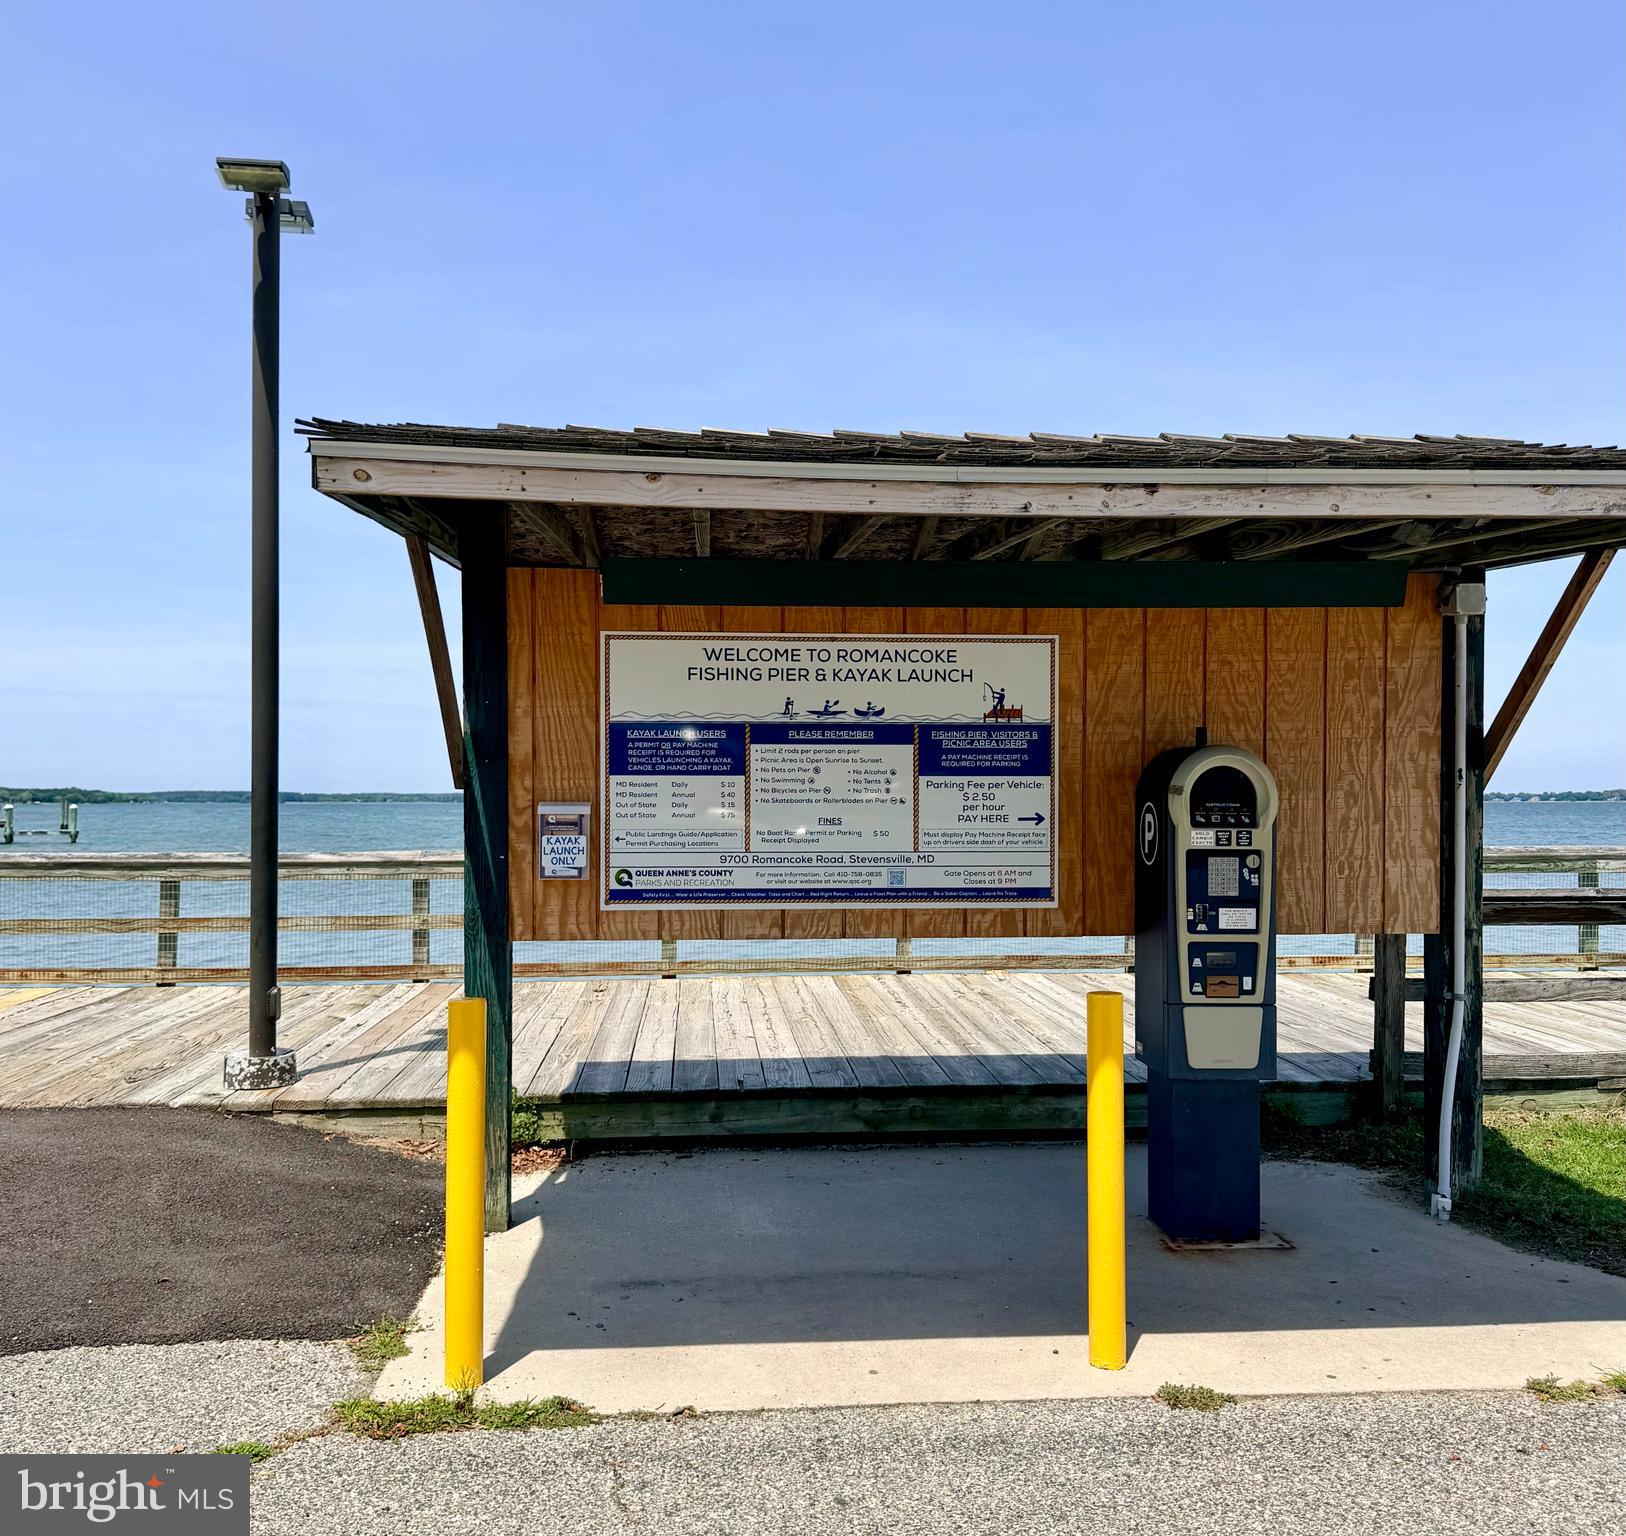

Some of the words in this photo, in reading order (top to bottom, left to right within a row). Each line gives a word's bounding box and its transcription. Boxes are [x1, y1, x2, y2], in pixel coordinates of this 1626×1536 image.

[704, 647, 801, 662] WELCOME
[807, 648, 831, 664] TO
[837, 648, 957, 664] ROMANCOKE
[688, 667, 762, 682] FISHING
[768, 667, 809, 682] PIER
[815, 667, 826, 683] &
[833, 667, 892, 683] KAYAK
[898, 667, 973, 683] LAUNCH
[627, 729, 656, 738] KAYAK
[658, 729, 700, 738] LAUNCH
[701, 729, 726, 738] USERS
[789, 730, 822, 739] PLEASE
[825, 730, 874, 739] REMEMBER
[932, 730, 966, 740] FISHING
[991, 730, 1030, 740] VISITORS
[942, 740, 970, 748] PICNIC
[973, 740, 997, 748] AREA
[999, 740, 1028, 748] USERS
[801, 748, 812, 756] per
[813, 748, 836, 756] person
[672, 781, 688, 790] Daily
[771, 777, 806, 785] Swimming
[926, 780, 964, 792] Parking
[967, 780, 985, 789] Fee
[988, 780, 1004, 792] per
[1007, 780, 1044, 789] Vehicle:
[771, 787, 797, 795] Bicycles
[963, 792, 969, 802] $
[972, 792, 996, 802] 2.50
[672, 801, 688, 810] Daily
[963, 803, 979, 812] per
[982, 803, 1005, 811] hour
[818, 817, 842, 826] FINES
[958, 814, 978, 823] PAY
[981, 814, 1009, 823] HERE
[647, 830, 677, 839] Landings
[678, 830, 738, 839] Guide/Application
[837, 830, 862, 838] Parking
[1145, 814, 1154, 853] P
[547, 836, 580, 845] KAYAK
[649, 840, 686, 849] Purchasing
[543, 846, 585, 856] LAUNCH
[551, 856, 576, 866] ONLY
[720, 854, 749, 864] 9700
[752, 854, 813, 864] Romancoke
[816, 854, 846, 865] Road,
[849, 854, 914, 865] Stevensville,
[917, 854, 935, 864] MD
[962, 870, 986, 878] Opens
